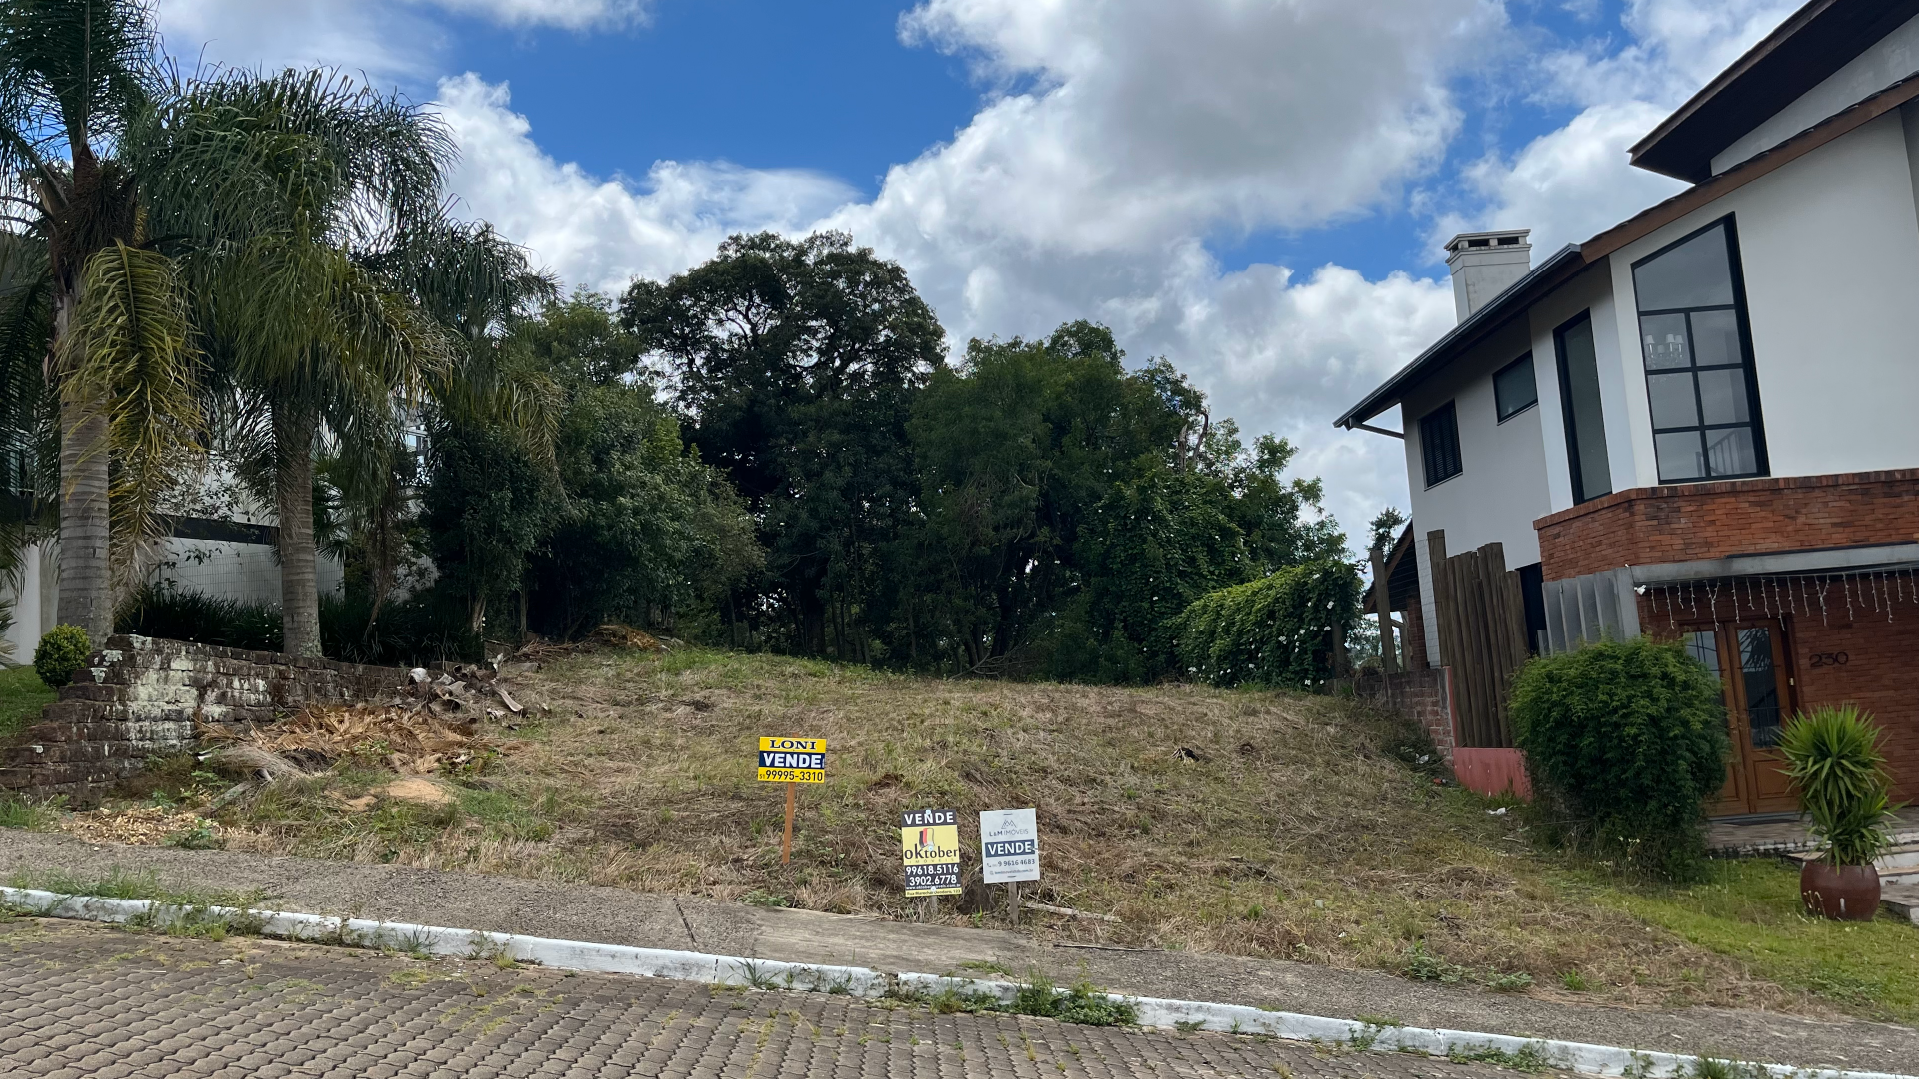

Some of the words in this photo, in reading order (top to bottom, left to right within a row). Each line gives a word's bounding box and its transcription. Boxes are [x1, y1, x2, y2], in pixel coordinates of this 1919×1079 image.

[769, 740, 817, 750] LONI
[763, 753, 822, 768] VENDE
[765, 770, 823, 782] 99995-3310
[904, 812, 954, 825] VENDE
[1004, 828, 1029, 836] IMÓVEIS
[988, 842, 1032, 855] VENDE
[1003, 859, 1019, 867] 9616
[906, 865, 959, 875] 99618.5116
[909, 875, 957, 886] 3902.6778
